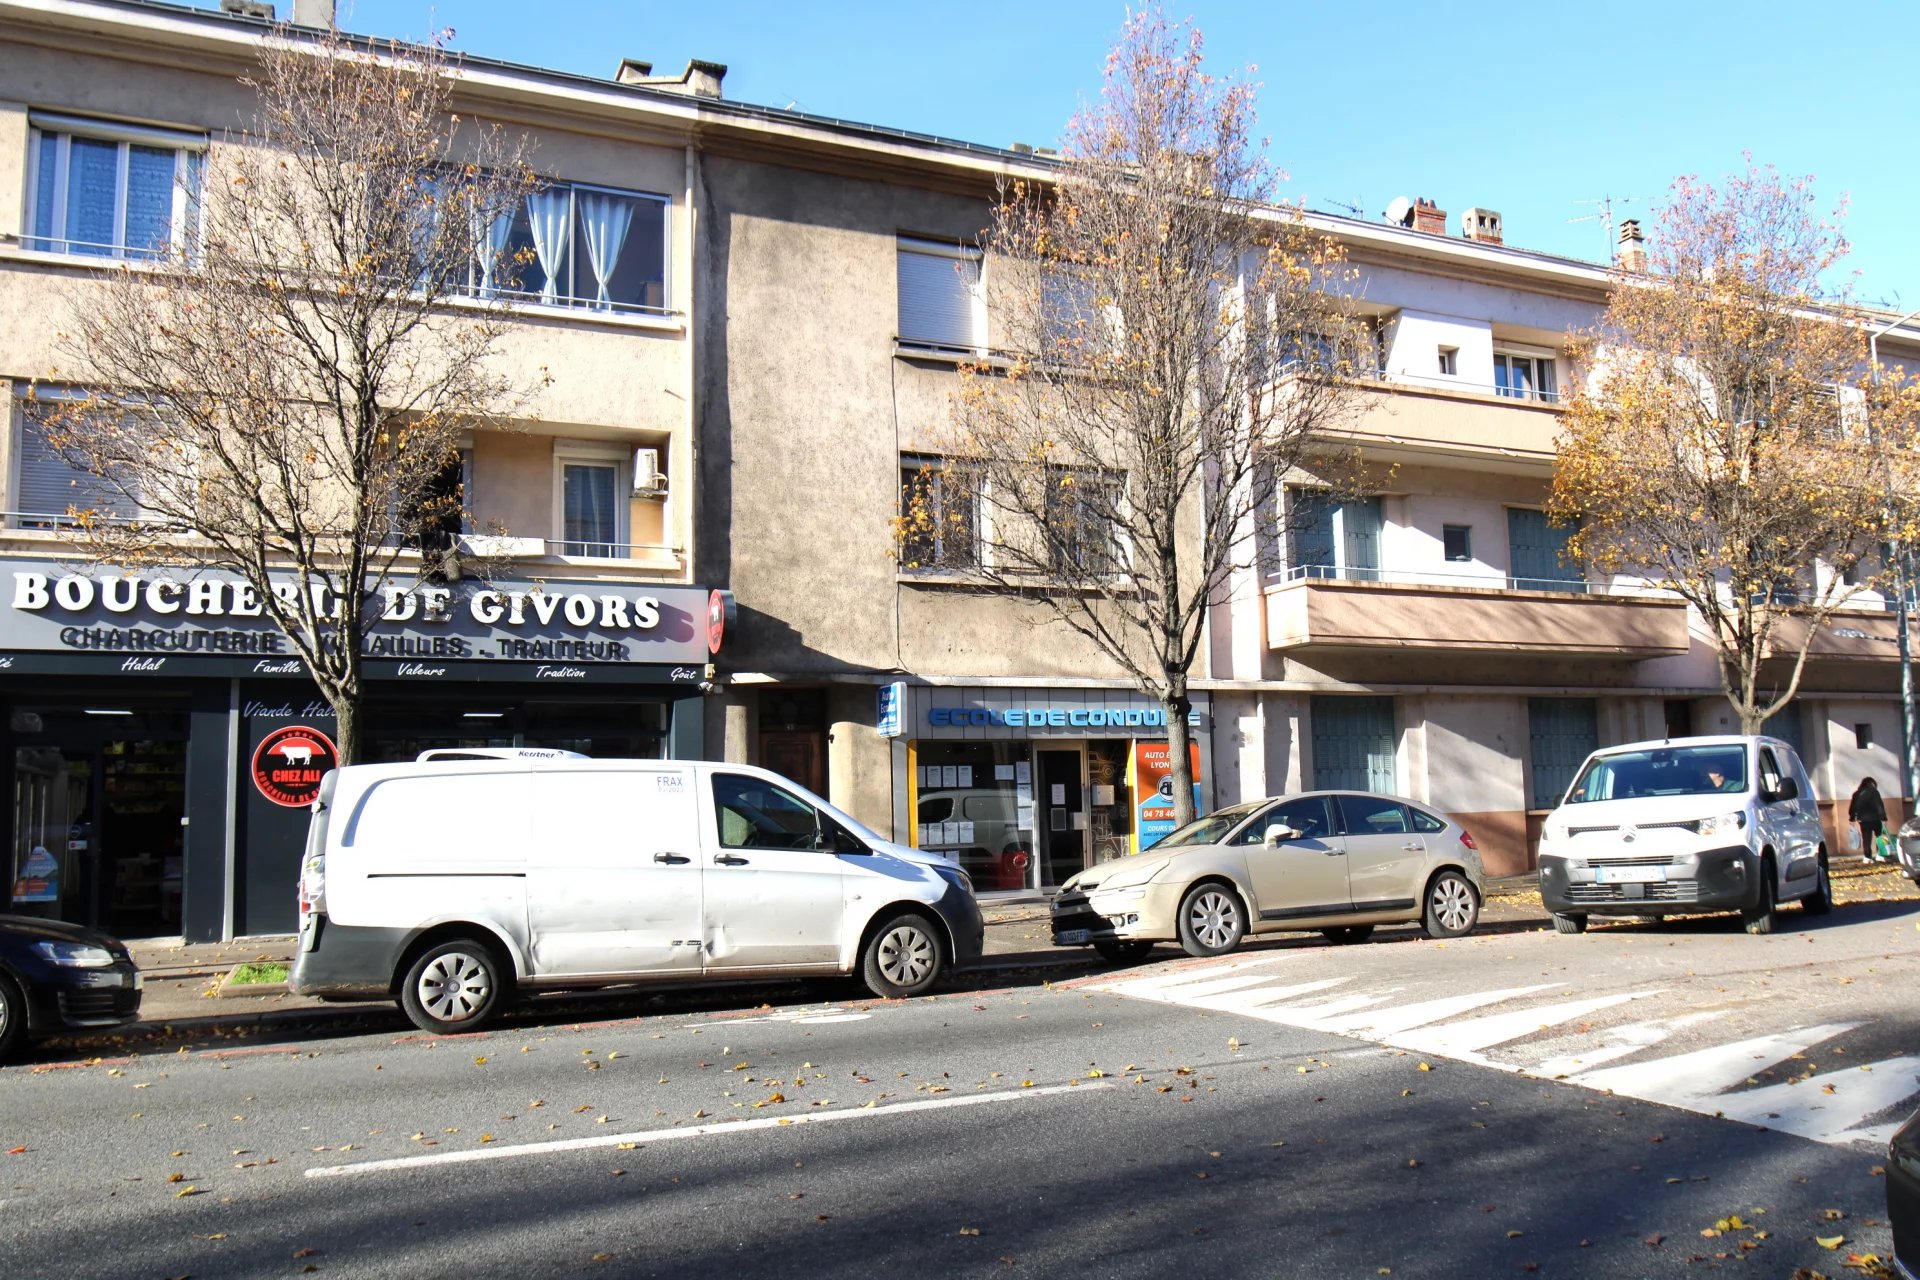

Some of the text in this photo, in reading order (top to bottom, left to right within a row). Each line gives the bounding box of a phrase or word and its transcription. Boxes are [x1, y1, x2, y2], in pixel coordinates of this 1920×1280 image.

[380, 586, 453, 621] DE
[470, 589, 660, 629] GIVORS
[60, 626, 624, 660] CHARCUTERIE AILLES TRAITEUR
[121, 656, 696, 681] Halal Famille Valeurs Tradition Goût
[243, 700, 339, 718] Viande Hala
[929, 709, 1024, 726] ECOLE
[1070, 708, 1200, 727] CONDUIE
[518, 750, 556, 759] Kerstner
[1144, 751, 1165, 759] AUTO
[1150, 761, 1170, 769] LYON
[272, 769, 320, 782] CHEZ ALI
[656, 776, 683, 786] FRAX
[1143, 809, 1175, 818] 04 78 46
